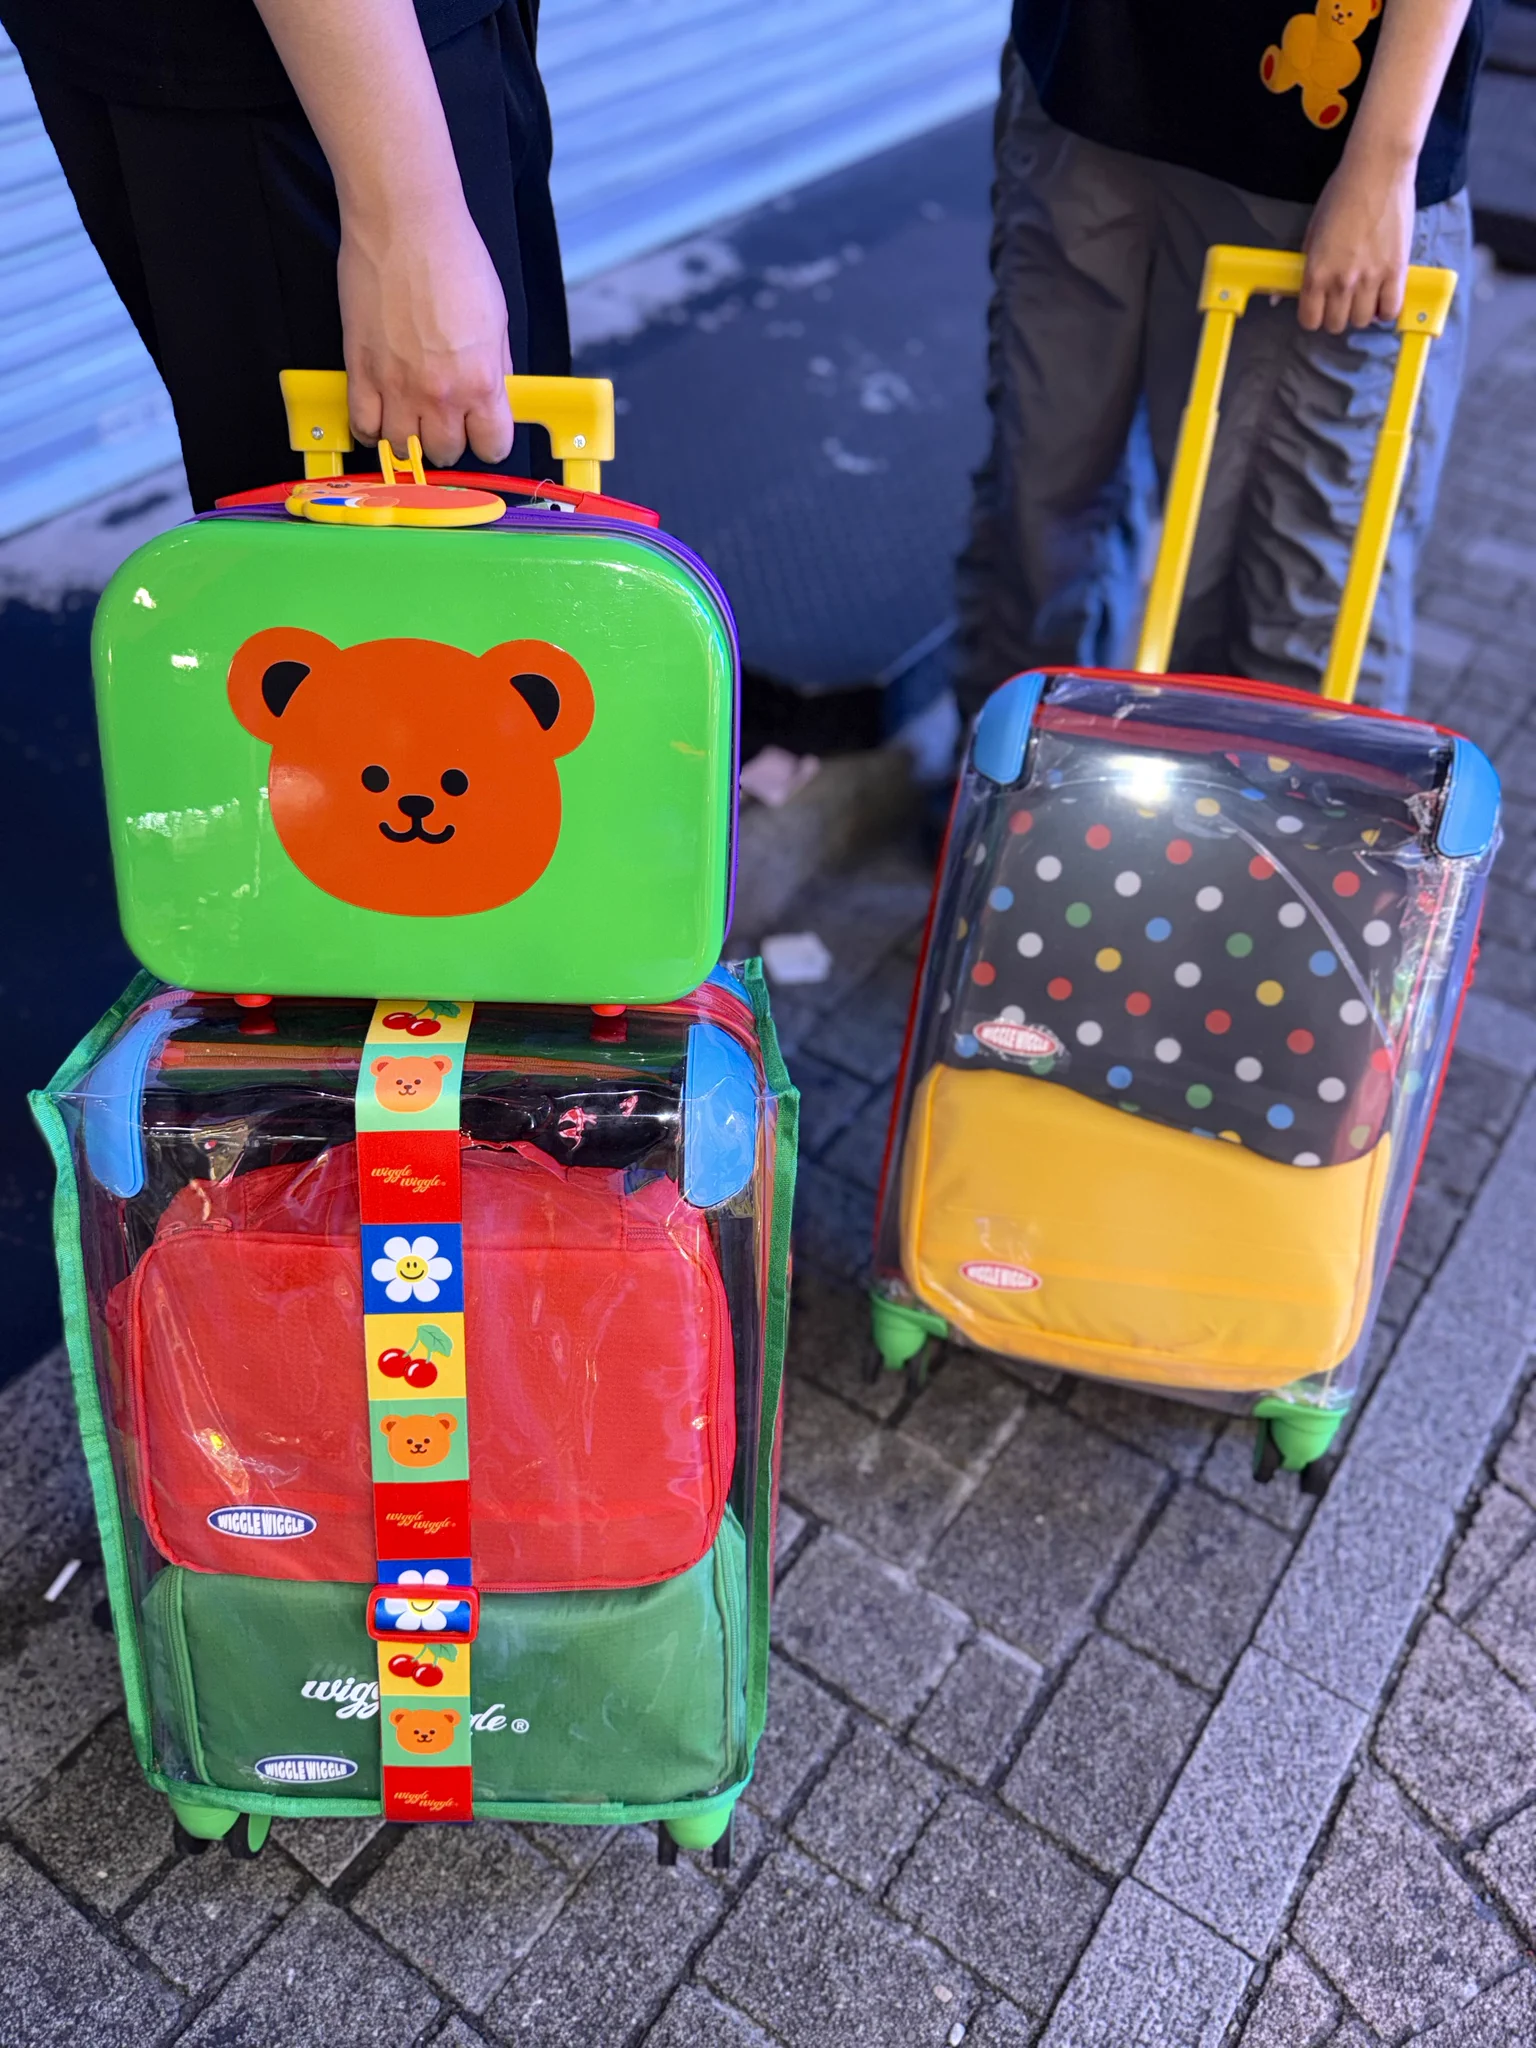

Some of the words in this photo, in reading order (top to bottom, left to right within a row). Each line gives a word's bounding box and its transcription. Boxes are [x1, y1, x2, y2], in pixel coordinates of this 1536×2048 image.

[371, 1164, 412, 1184] wiggle
[400, 1174, 440, 1193] wiggle
[217, 1512, 261, 1535] WIGGLE
[261, 1513, 305, 1536] WIGGLE
[386, 1510, 424, 1527] wiggle
[412, 1517, 451, 1534] wiggle
[264, 1761, 306, 1780] WIGGLE
[305, 1761, 347, 1780] WIGGLE
